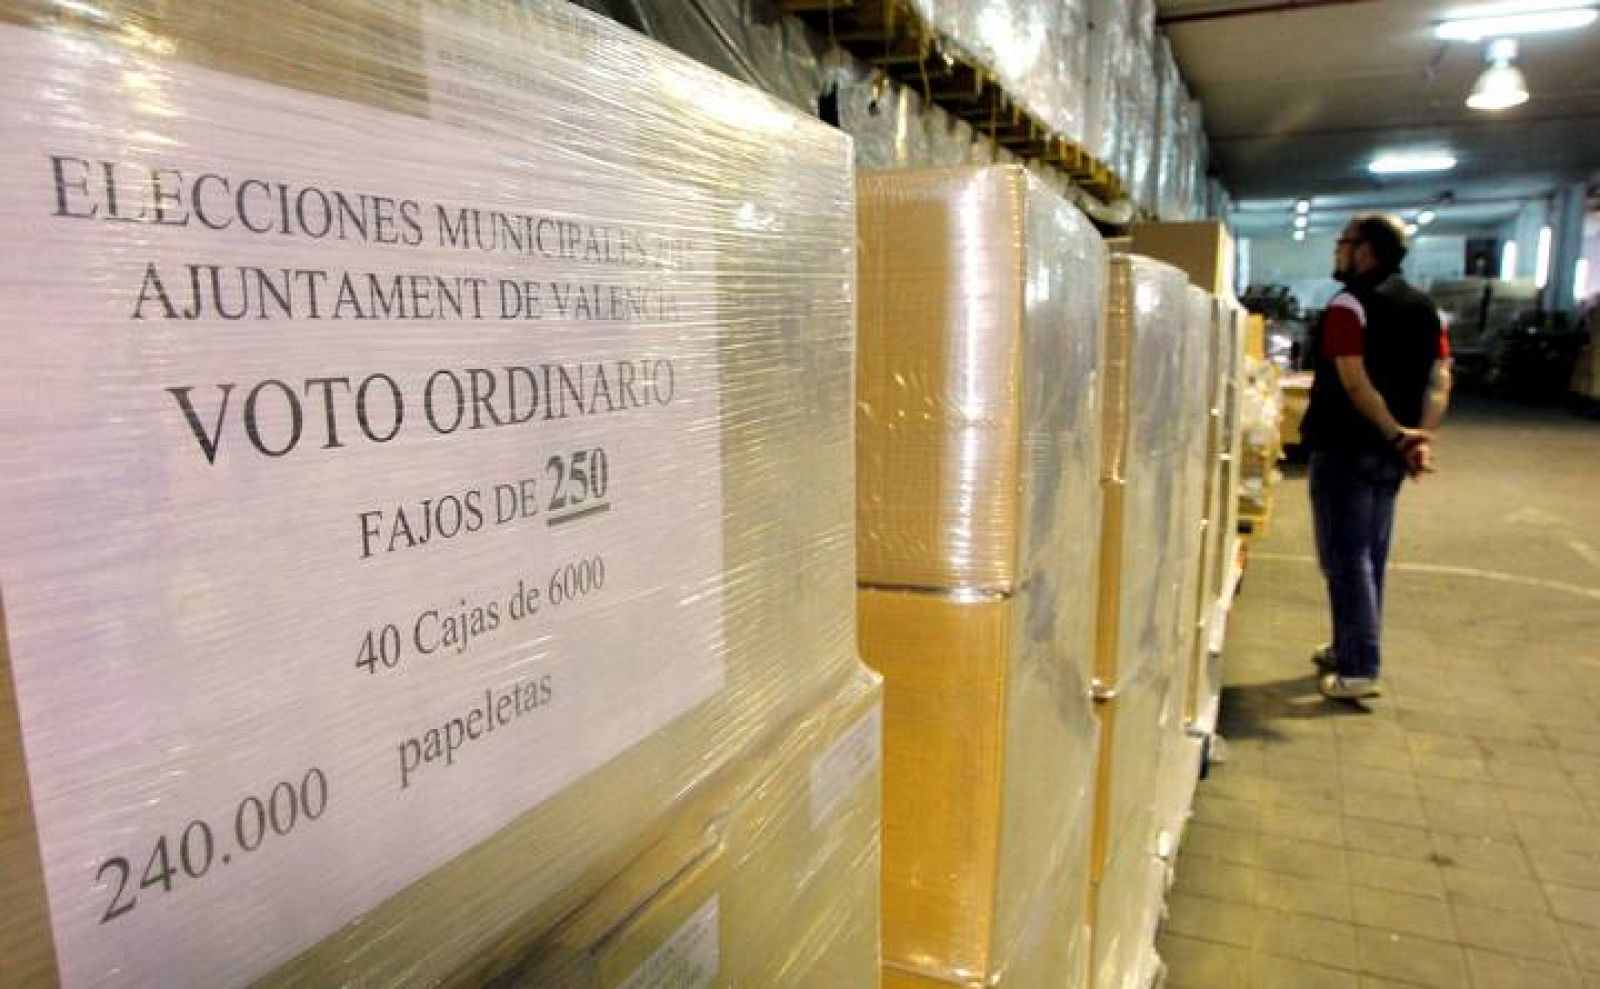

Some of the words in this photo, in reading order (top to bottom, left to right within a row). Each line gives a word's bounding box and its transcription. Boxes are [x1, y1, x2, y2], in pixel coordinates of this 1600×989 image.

[50, 154, 423, 246] ELECCIONES
[436, 203, 647, 268] MUNICIPALES
[131, 261, 487, 320] AJUNTAMENT
[500, 279, 541, 320] DE
[164, 372, 405, 466] VOTO
[424, 359, 675, 434] ORDINARIO
[359, 489, 483, 559] FAJOS
[495, 477, 540, 525] DE
[546, 446, 609, 527] 250
[355, 623, 401, 674] 40
[413, 598, 500, 655] Cajas
[509, 579, 541, 621] de
[549, 555, 606, 606] 6000
[95, 766, 328, 924] 240.000
[398, 674, 553, 789] papeletas
